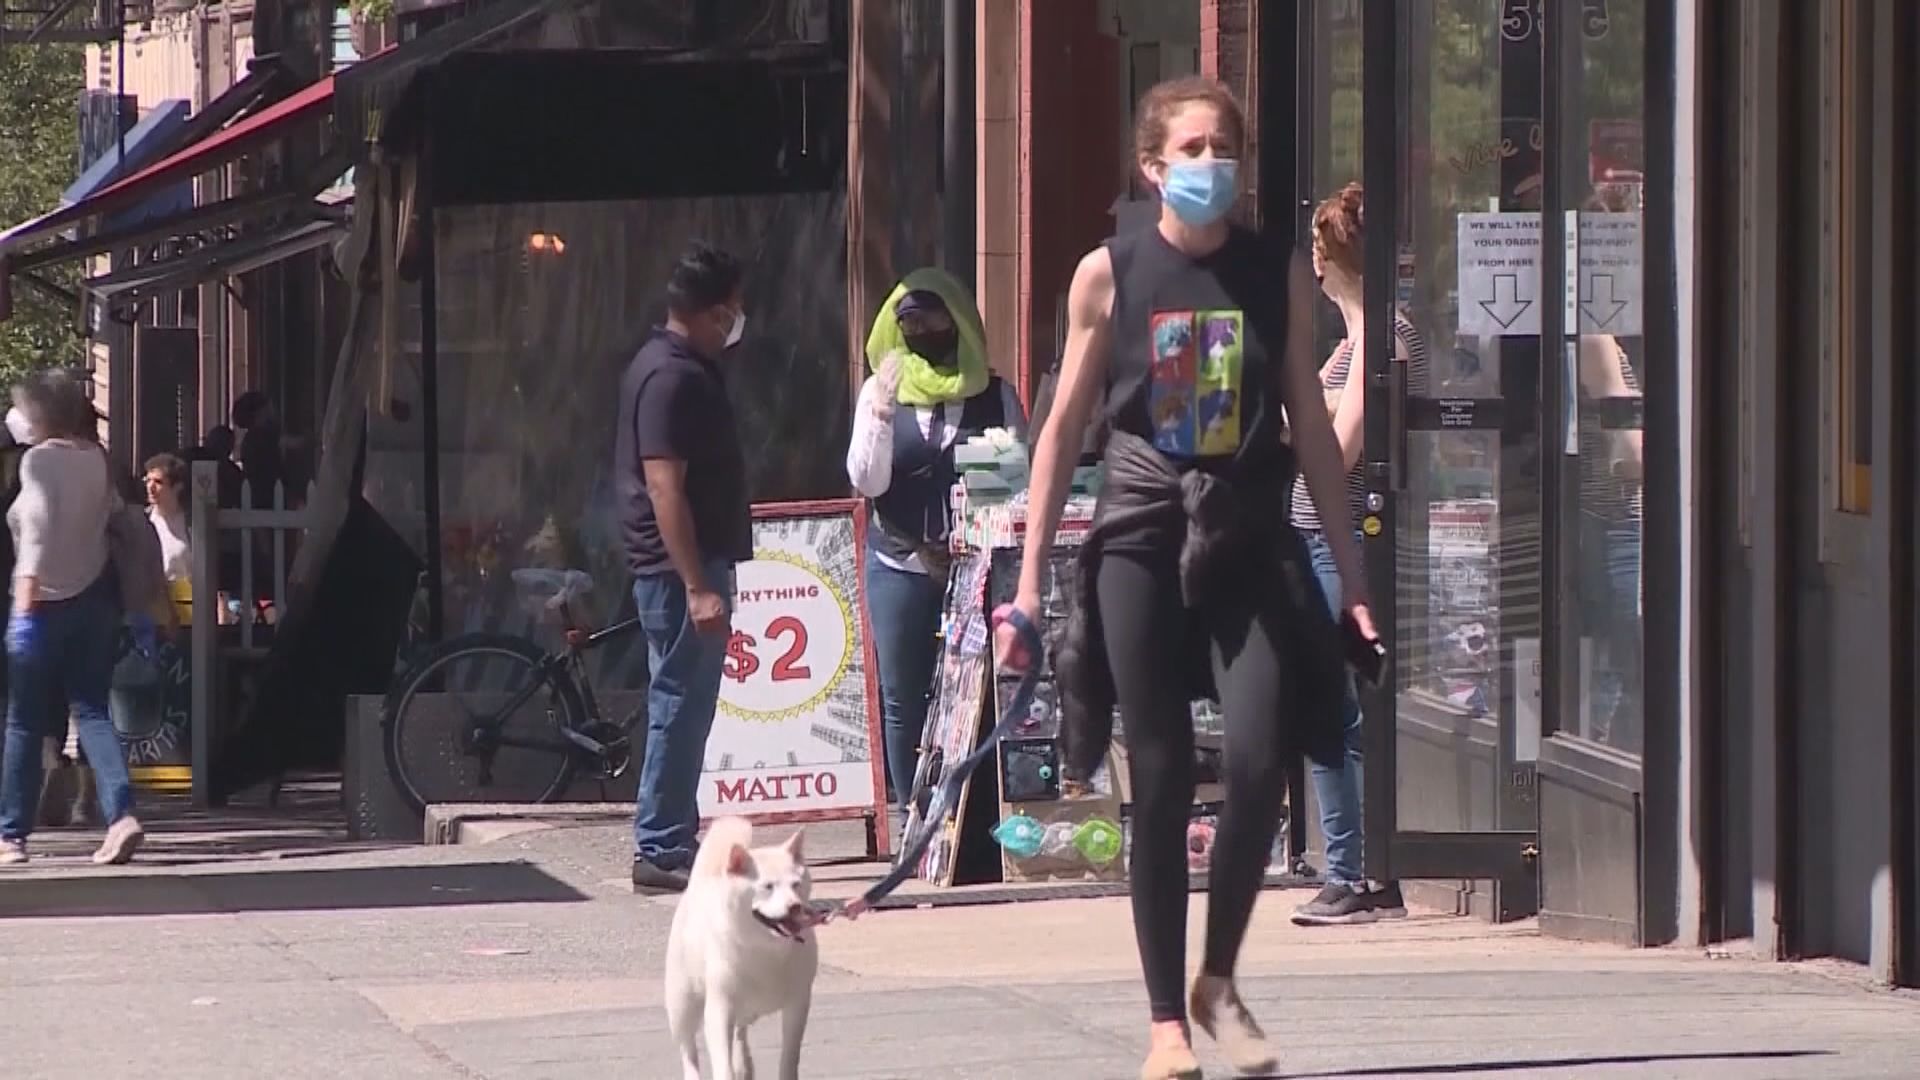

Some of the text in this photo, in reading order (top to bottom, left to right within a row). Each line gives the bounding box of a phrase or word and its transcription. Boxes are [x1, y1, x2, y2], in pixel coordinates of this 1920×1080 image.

[1473, 239, 1540, 247] YOUR ORDER
[1478, 258, 1534, 267] FROM HERE
[723, 616, 811, 683] $2
[714, 772, 837, 803] MATTO
